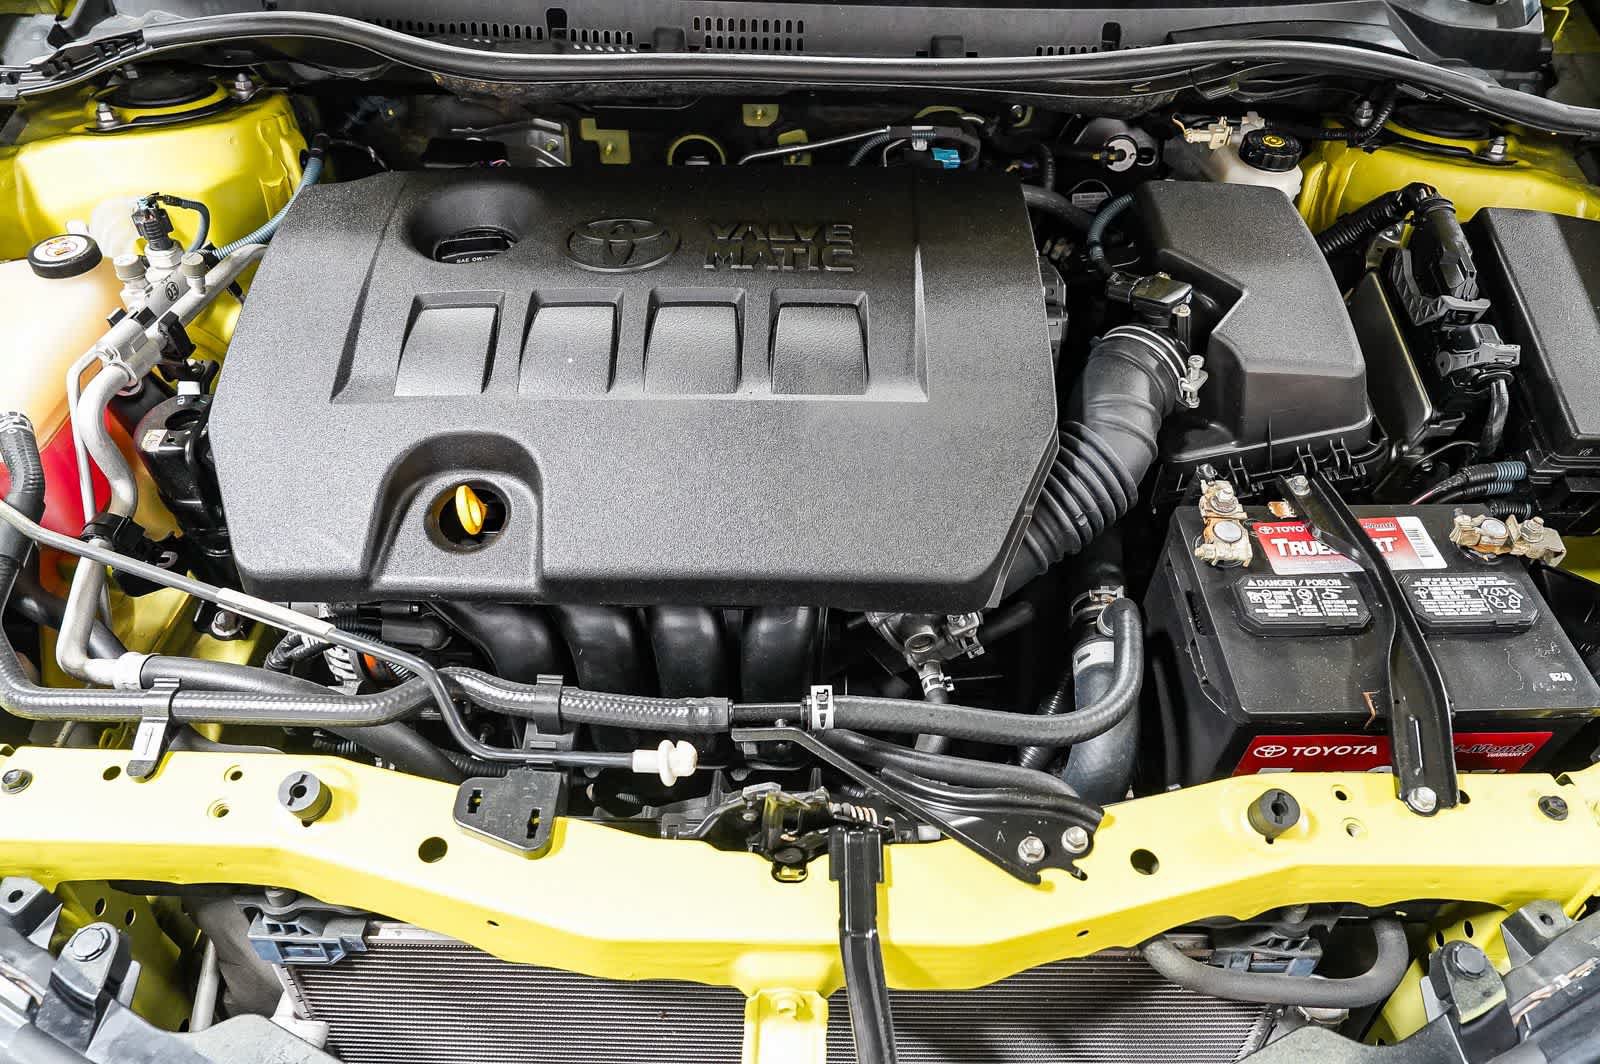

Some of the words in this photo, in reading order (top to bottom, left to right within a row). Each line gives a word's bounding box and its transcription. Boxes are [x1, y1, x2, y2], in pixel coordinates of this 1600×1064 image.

[709, 223, 853, 243] VALVE
[703, 244, 854, 272] MATIC
[1275, 525, 1306, 533] TOYO
[1256, 579, 1297, 587] DANGER
[1304, 578, 1342, 587] POISON
[1292, 745, 1378, 757] TOYOTA
